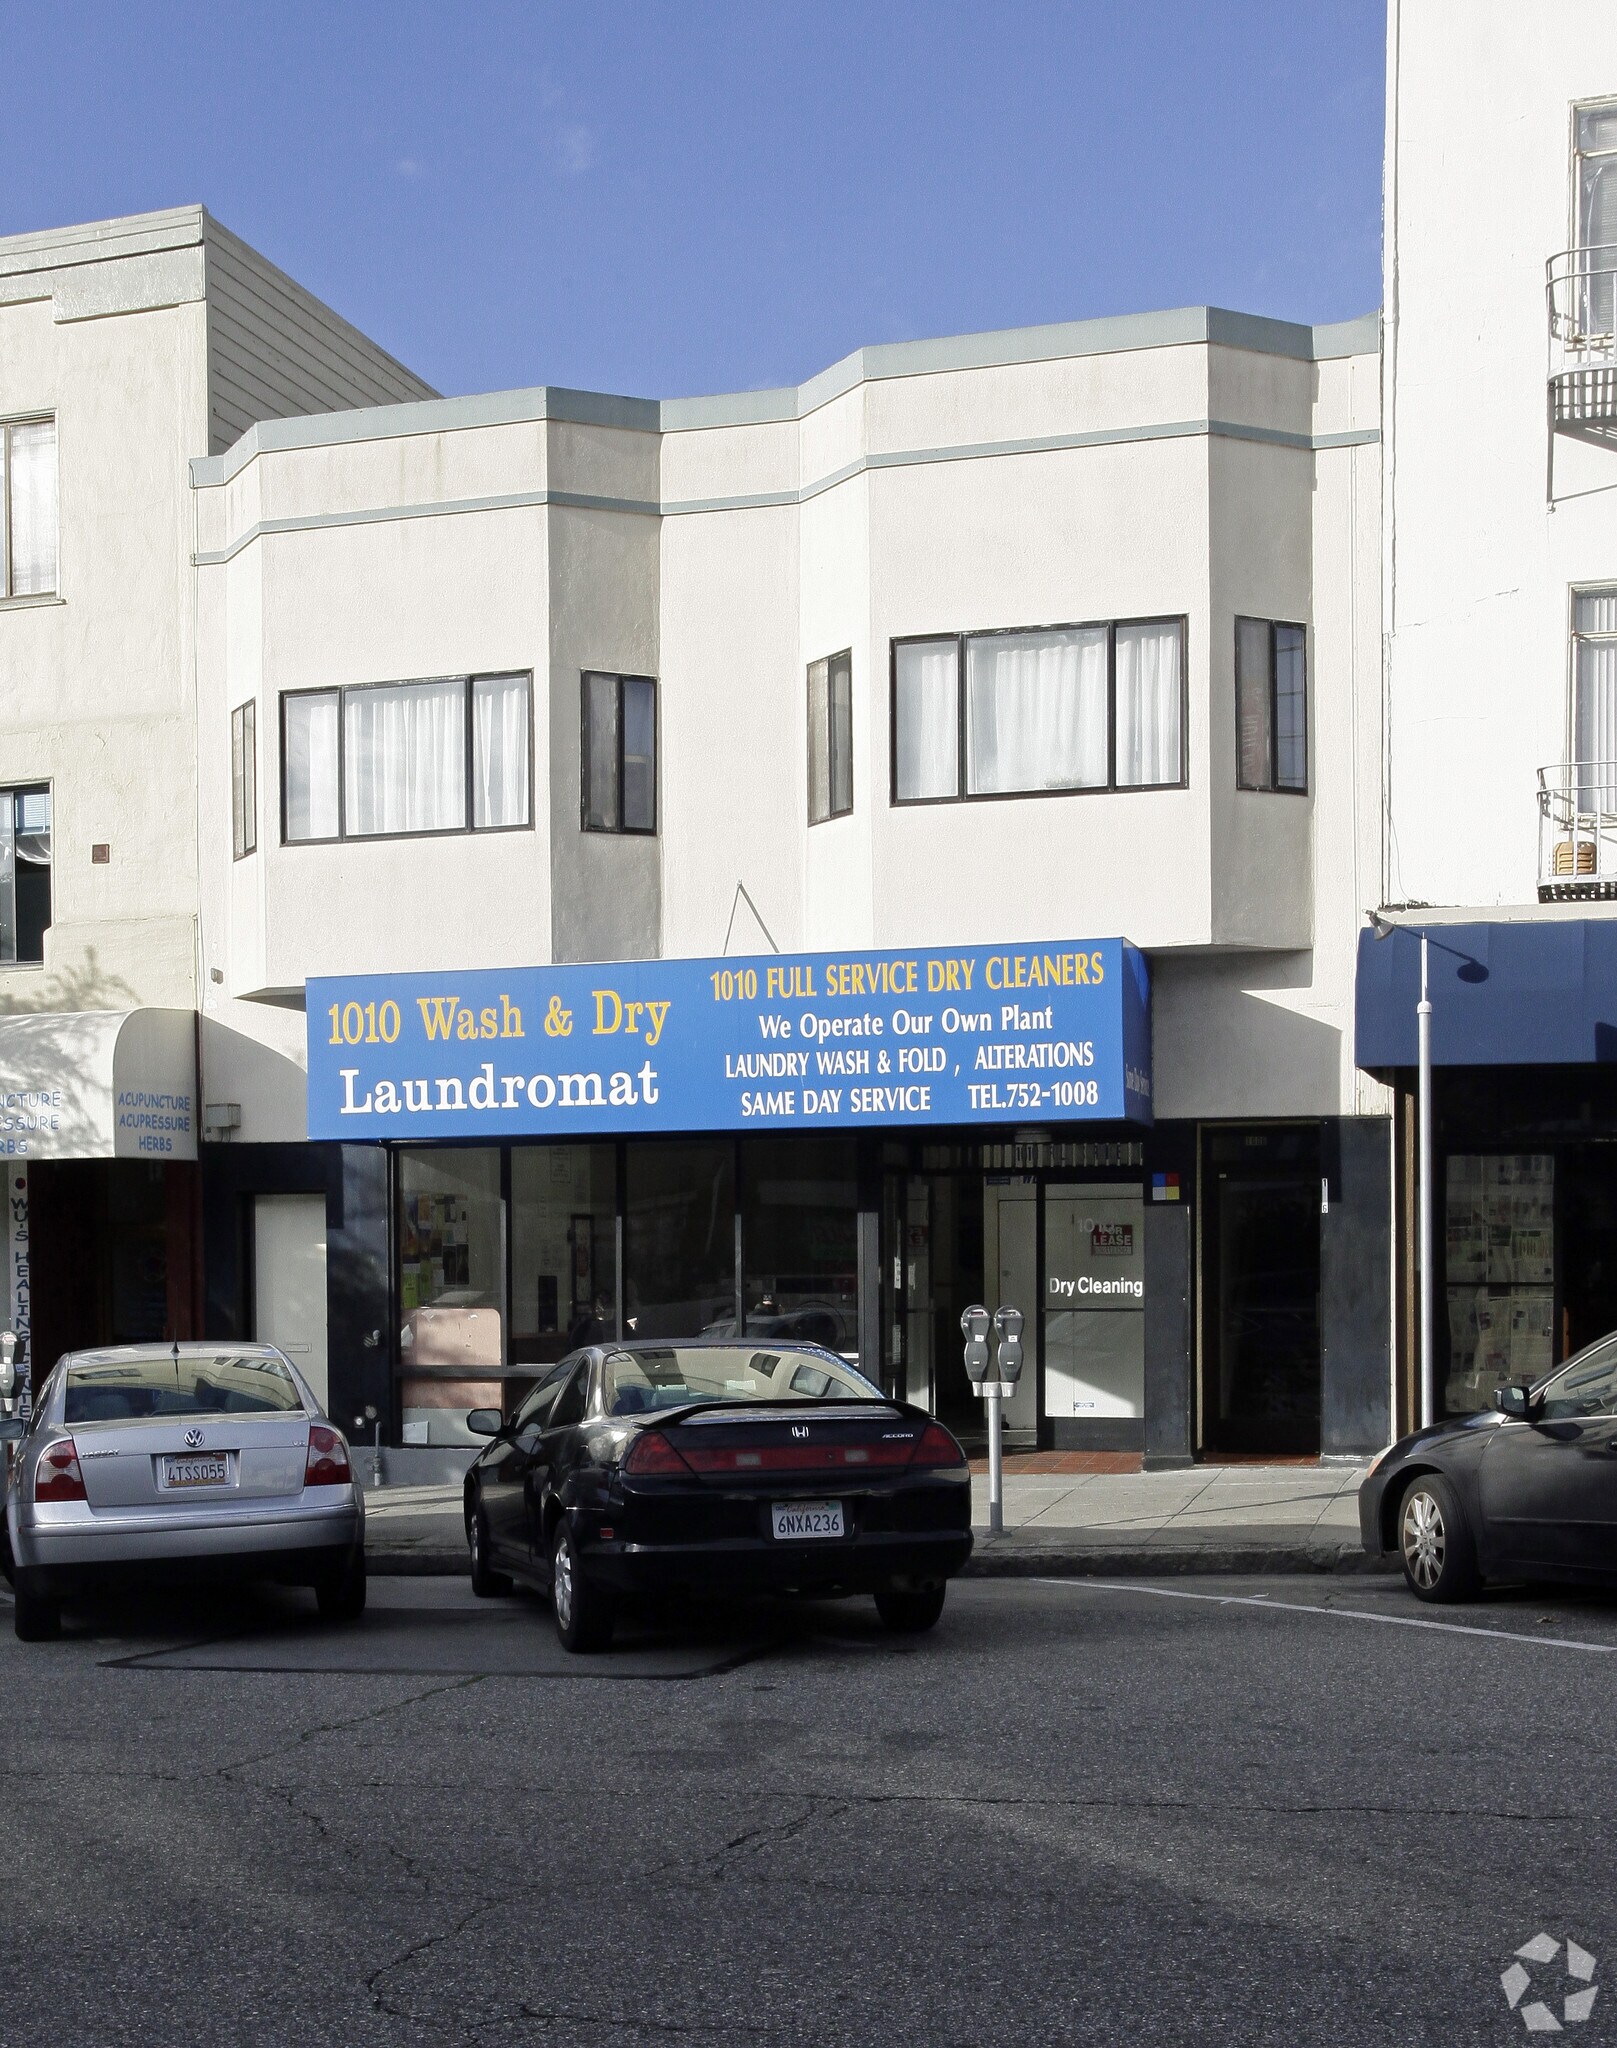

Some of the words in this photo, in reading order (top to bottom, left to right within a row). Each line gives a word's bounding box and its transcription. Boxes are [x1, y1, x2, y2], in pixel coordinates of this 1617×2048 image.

[710, 969, 758, 1001] 1010
[767, 966, 817, 999] FULL
[826, 960, 918, 997] SERVICE
[927, 959, 976, 993] DRY
[985, 951, 1104, 990] CLEANERS
[328, 1000, 400, 1044] 1010
[417, 994, 524, 1040] Wash
[544, 995, 573, 1037] &
[592, 990, 671, 1046] Dry
[758, 1014, 792, 1039] We
[800, 1012, 884, 1044] Operate
[892, 1009, 933, 1035] Our
[941, 1007, 992, 1034] Own
[1001, 1004, 1053, 1031] Plant
[725, 1052, 809, 1078] LAUNDRY
[816, 1050, 870, 1075] WASH
[877, 1050, 891, 1074] &
[898, 1047, 947, 1073] FOLD
[974, 1041, 1095, 1070] ALTERATIONS
[118, 1091, 191, 1111] ACUPUNCTURE
[339, 1060, 659, 1114] Laundromat
[741, 1091, 795, 1117] SAME
[803, 1089, 843, 1114] DAY
[850, 1086, 931, 1113] SERVICE
[967, 1080, 1099, 1110] TEL.752-1008
[0, 1114, 60, 1131] SSURE
[119, 1113, 191, 1132] ACUPRESSURE
[138, 1135, 173, 1152] HERBS
[10, 1197, 29, 1242] WU'S
[1092, 1235, 1132, 1246] LEASE
[15, 1252, 31, 1343] HEALING
[1049, 1277, 1075, 1297] Dry
[1077, 1276, 1143, 1298] Cleaning
[168, 1463, 226, 1481] 4TSS055
[778, 1514, 840, 1533] 6NXA236
